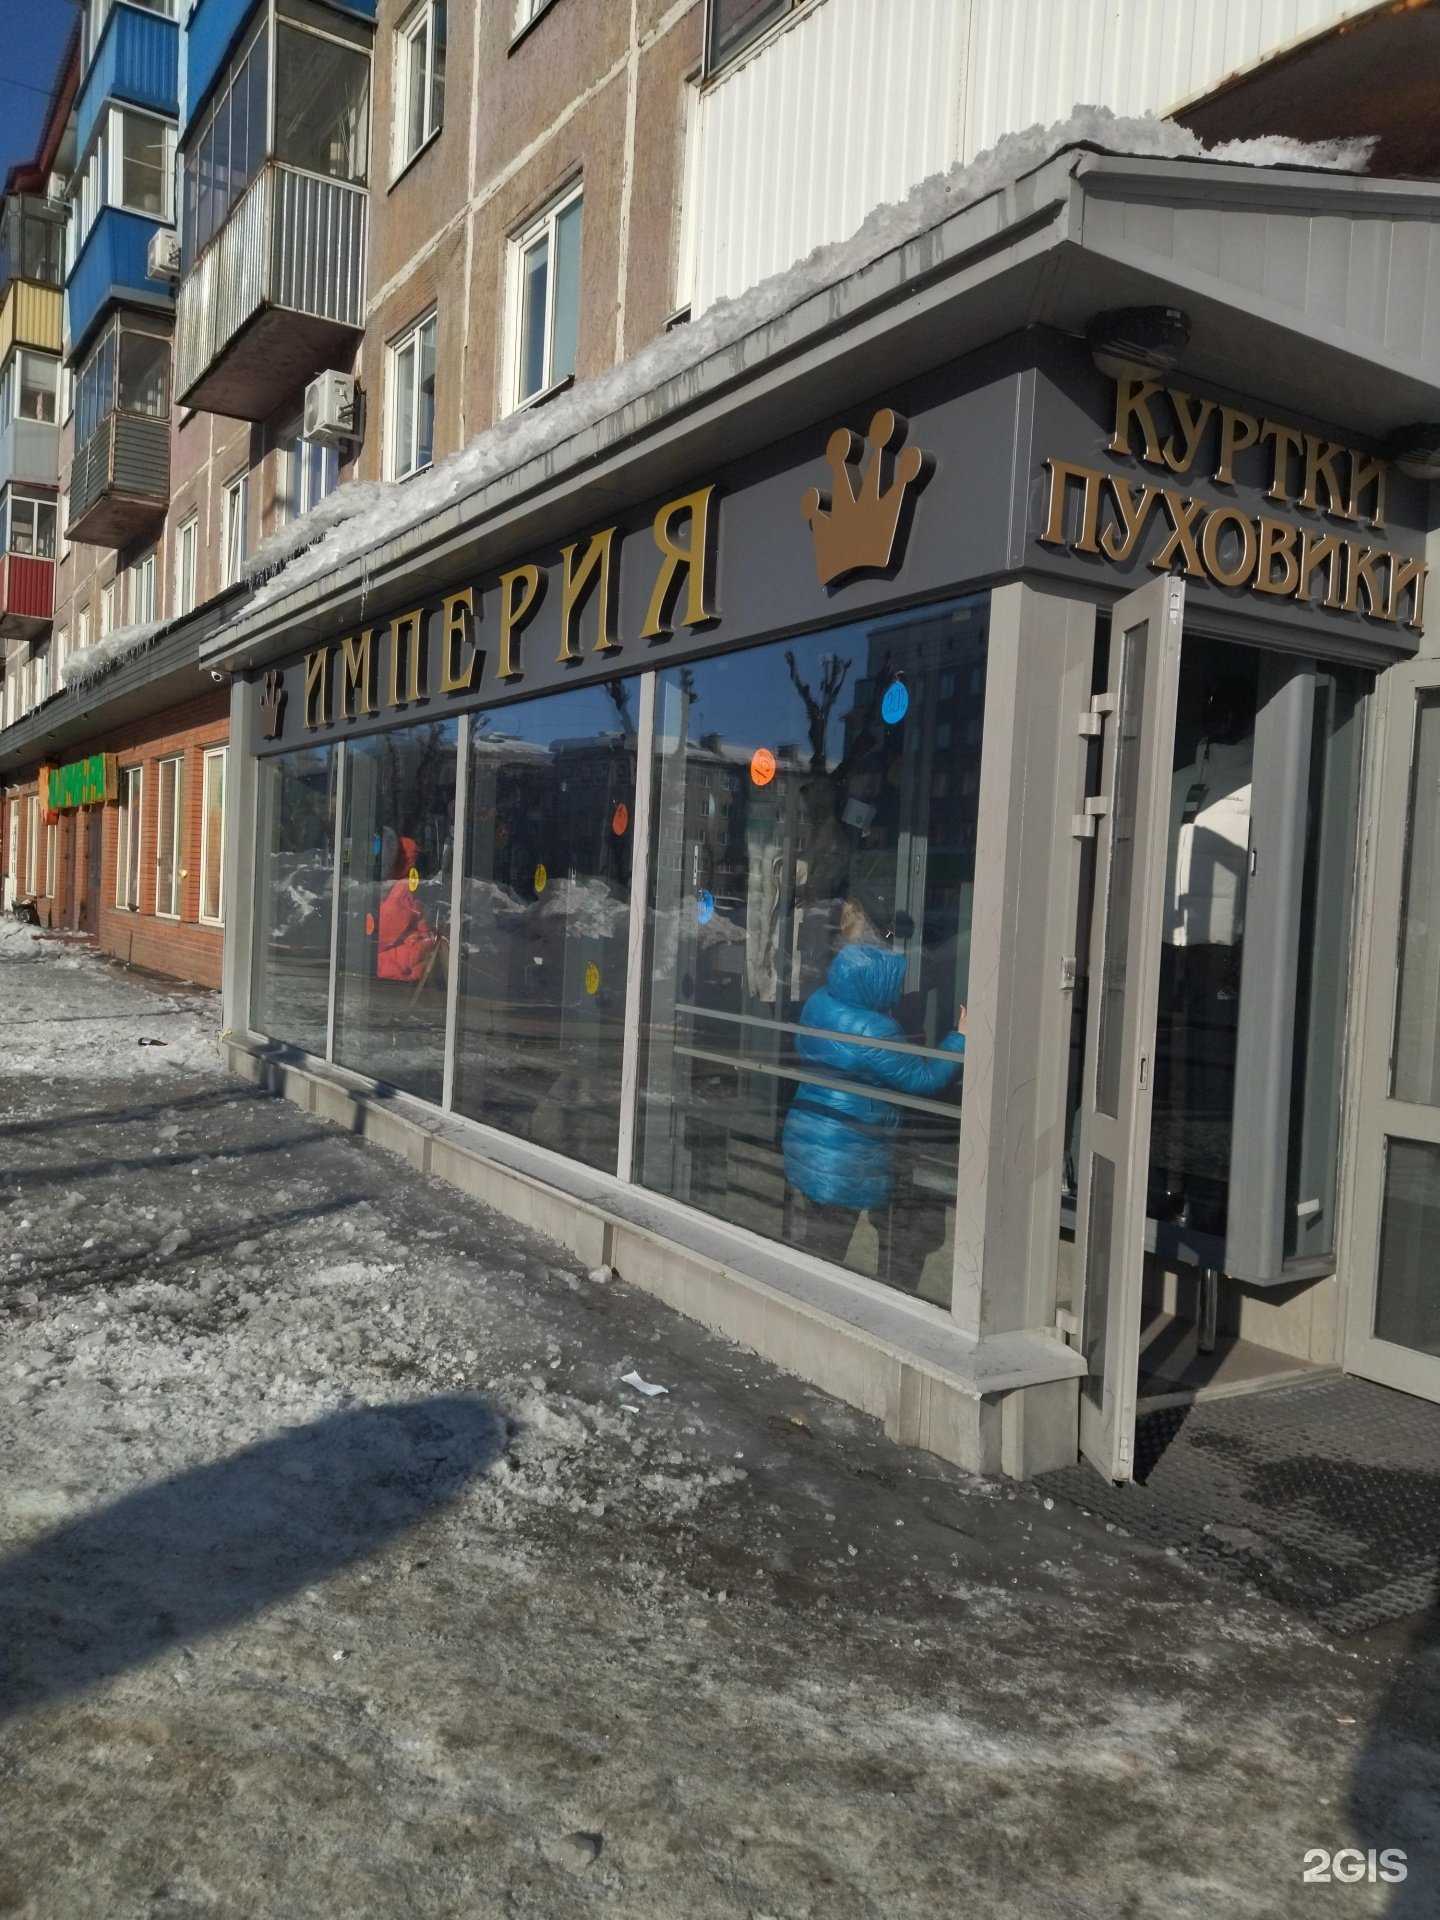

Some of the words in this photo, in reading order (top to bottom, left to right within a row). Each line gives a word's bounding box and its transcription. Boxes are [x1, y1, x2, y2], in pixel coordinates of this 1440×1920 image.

[1107, 376, 1390, 529] КУРТКИ
[303, 483, 720, 729] ИМПЕРИЯ
[1040, 457, 1429, 628] ПУХОВИКИ
